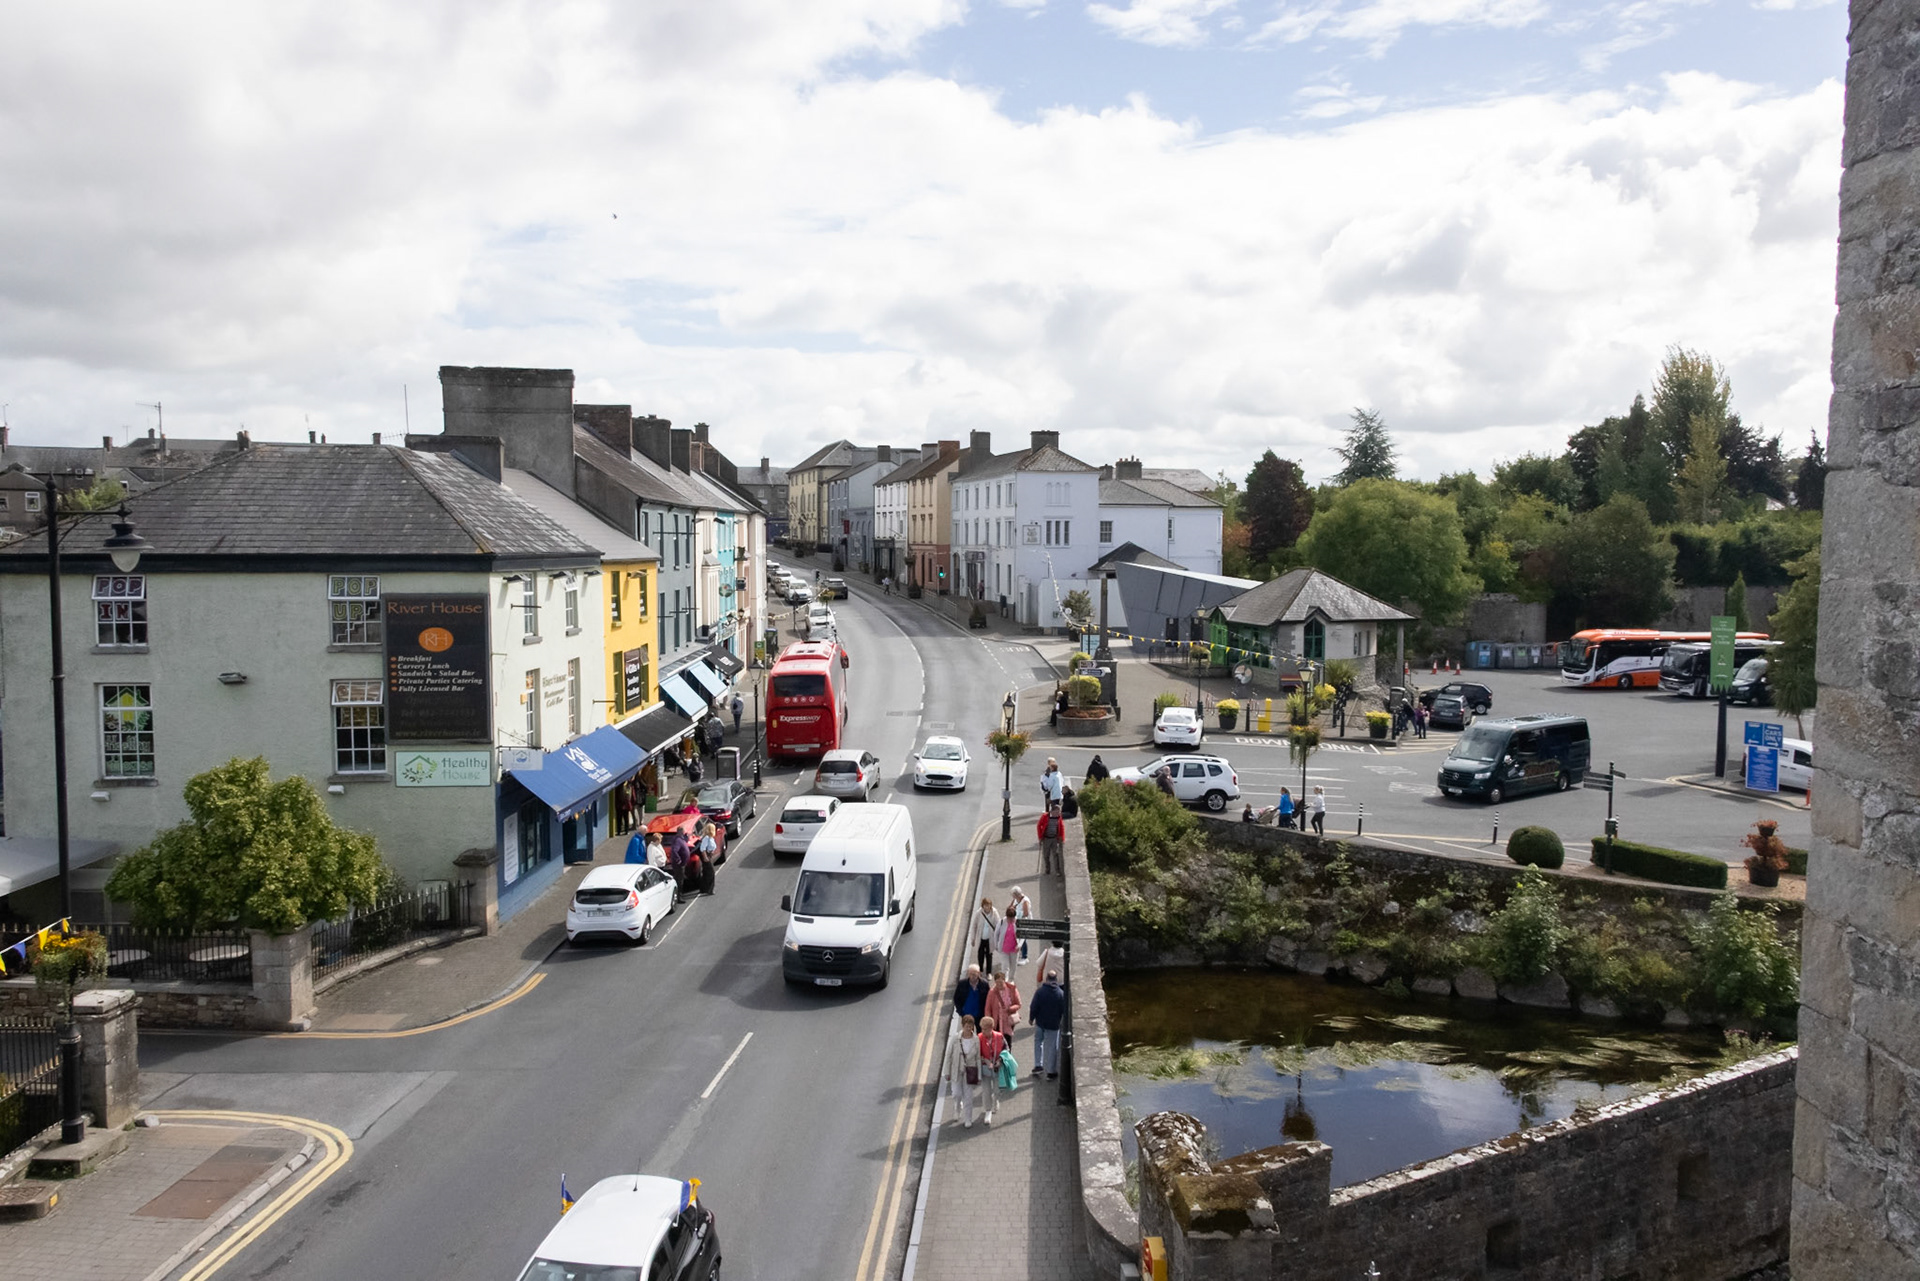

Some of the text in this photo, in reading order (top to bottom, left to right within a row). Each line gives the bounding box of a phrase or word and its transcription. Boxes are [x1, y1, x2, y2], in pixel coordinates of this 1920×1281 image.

[98, 578, 142, 594] POP
[332, 578, 377, 595] POP
[100, 602, 130, 620] IN
[333, 603, 363, 620] UP
[387, 602, 483, 614] River House
[780, 715, 821, 723] Expressway
[1317, 742, 1366, 752] ONLY
[441, 757, 488, 770] Healthy
[442, 770, 481, 780] House
